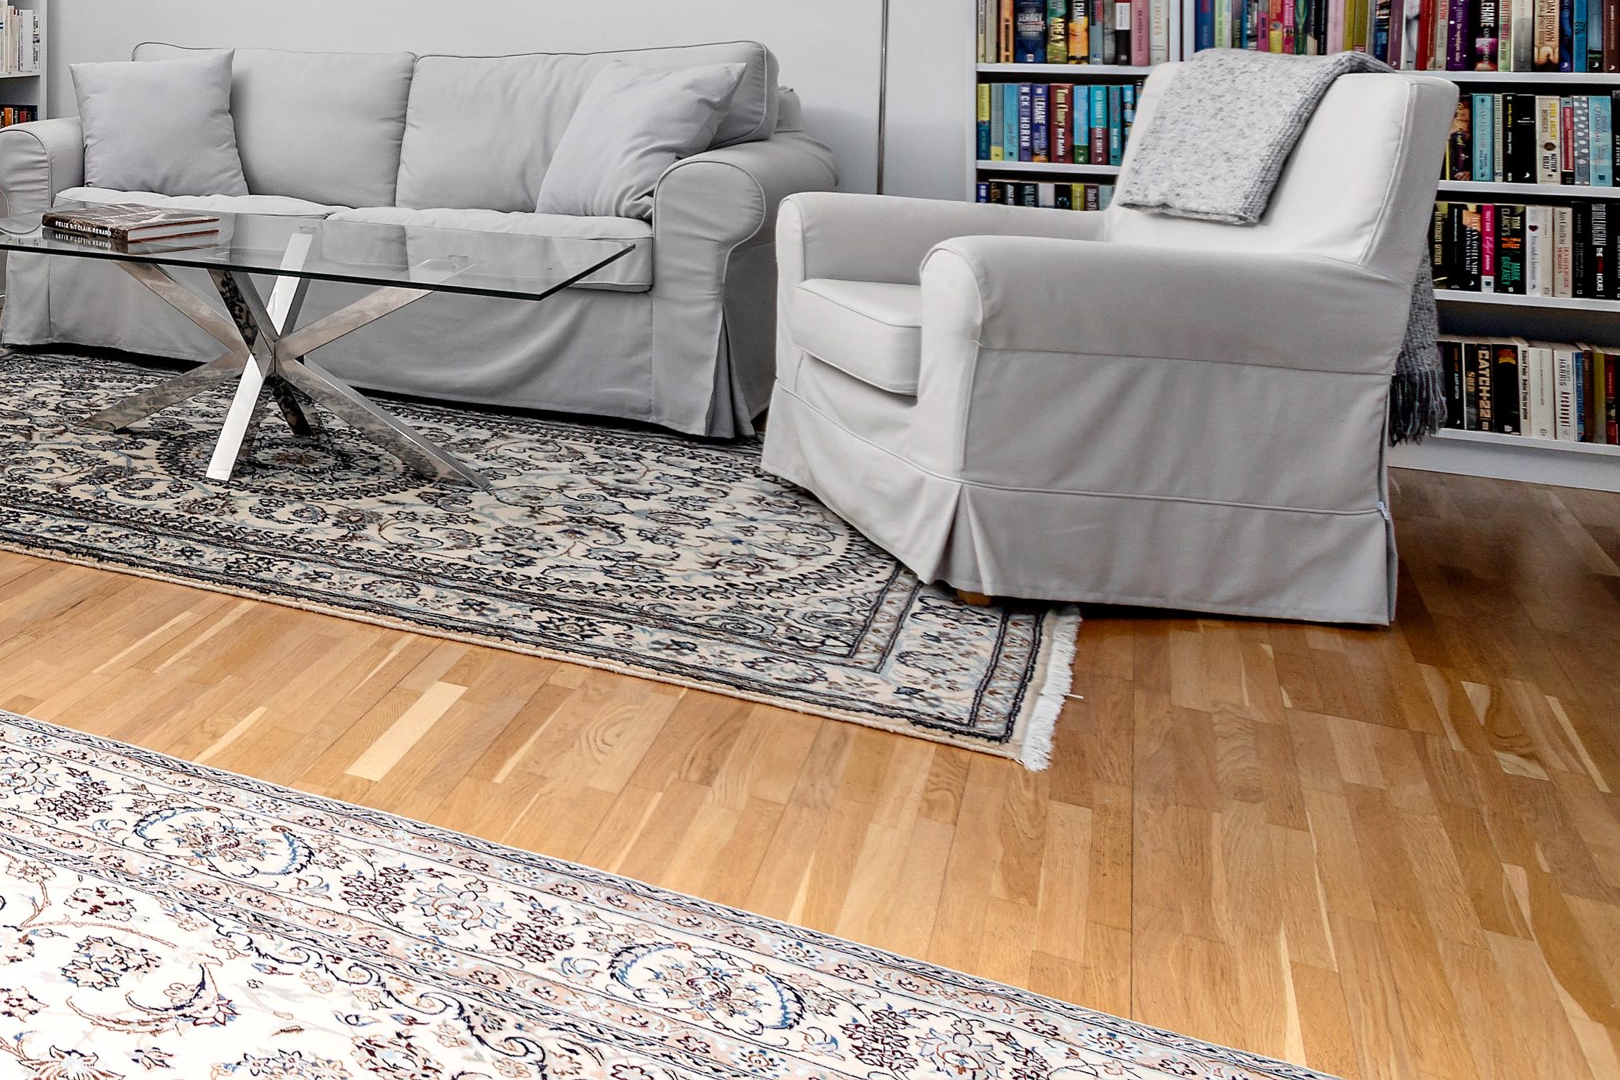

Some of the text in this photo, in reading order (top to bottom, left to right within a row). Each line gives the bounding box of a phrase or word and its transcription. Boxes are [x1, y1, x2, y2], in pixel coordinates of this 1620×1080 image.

[1051, 17, 1063, 40] AREA
[1154, 6, 1162, 35] MOYES
[1546, 0, 1556, 42] DAN BROWN
[1035, 98, 1045, 123] LEHANE
[1054, 88, 1068, 127] Tom Clancy
[55, 221, 69, 229] FELIX
[1501, 208, 1511, 236] CLANCY'S
[1511, 216, 1520, 229] TOM
[1559, 211, 1567, 222] Jan
[1592, 211, 1606, 245] BILLINGHAM
[1501, 257, 1510, 285] GREANEY
[1511, 263, 1520, 280] MARK
[1478, 350, 1491, 418] CATCH-22
[1559, 359, 1567, 386] HARRIS
